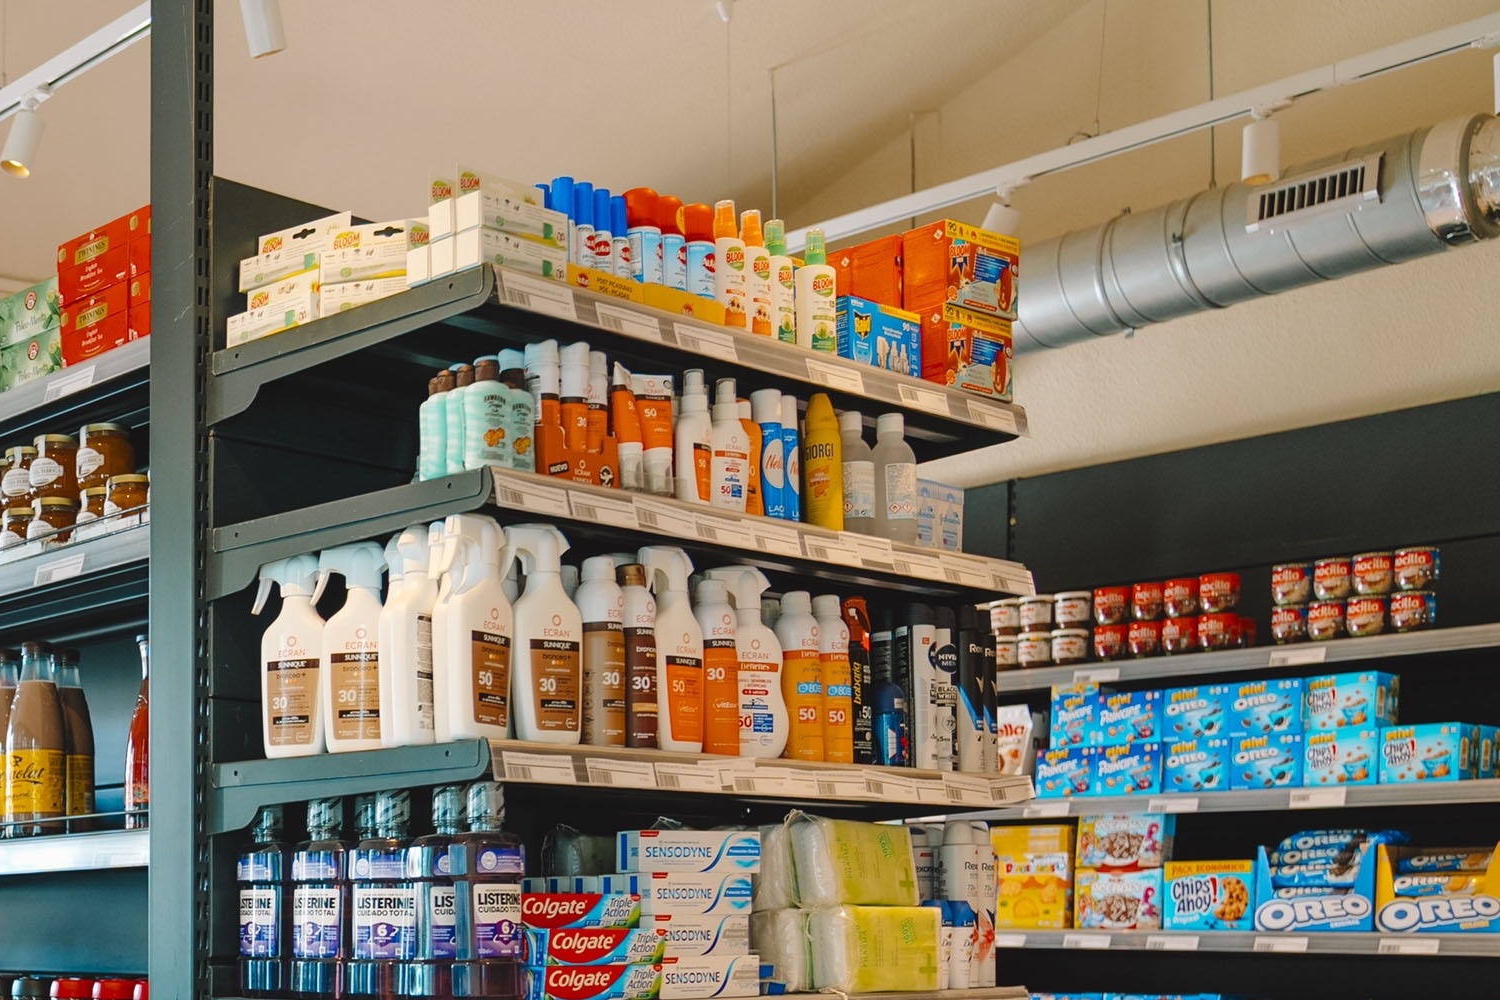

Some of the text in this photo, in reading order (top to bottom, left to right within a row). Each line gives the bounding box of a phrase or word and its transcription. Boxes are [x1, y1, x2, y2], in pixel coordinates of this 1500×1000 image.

[460, 177, 480, 189] BLOOM
[432, 185, 452, 198] BLOOM
[333, 232, 360, 250] BLOOM
[410, 231, 429, 244] BLOOM
[262, 238, 283, 254] BLOOM
[812, 279, 834, 291] BLOOM
[251, 293, 269, 309] BLOOM
[644, 408, 657, 418] 50
[550, 463, 568, 474] NUEVO
[720, 485, 731, 495] 50
[1355, 558, 1390, 572] nocilla
[483, 621, 506, 632] ECRAN
[543, 628, 570, 637] ECRAN
[345, 641, 377, 650] ECRAN
[278, 650, 305, 658] ECRAN
[742, 651, 769, 660] ECRAN
[478, 672, 493, 686] 50
[602, 672, 620, 685] 30
[706, 668, 725, 680] 30
[540, 678, 557, 692] 30
[632, 676, 650, 690] 30
[672, 680, 685, 692] 50
[338, 690, 356, 702] 30
[1233, 693, 1277, 711] OREO
[1307, 689, 1332, 704] Chips
[272, 697, 287, 709] 30
[1166, 700, 1208, 715] OREO
[799, 708, 816, 720] 50
[829, 711, 845, 723] 50
[1307, 745, 1331, 760] Chips
[1384, 741, 1409, 755] Chips
[1166, 752, 1207, 767] OREO
[1234, 748, 1278, 763] OREO
[1296, 835, 1350, 850] OREO
[645, 846, 712, 858] SENSODYNE
[1283, 849, 1338, 864] OREO
[657, 888, 712, 899] SENSODYNE
[1173, 880, 1211, 900] Chips
[357, 896, 414, 909] LISTERINE
[523, 897, 587, 917] Colgate
[610, 898, 633, 910] Triple
[357, 909, 414, 917] CUIDADO TOTAL
[478, 905, 508, 914] CUIDADO
[603, 907, 630, 919] Action
[1258, 894, 1370, 931] OREO
[1378, 894, 1500, 932] OREO
[377, 924, 387, 938] 6
[501, 921, 510, 934] 6
[637, 933, 659, 946] Triple
[664, 930, 711, 941] ENSODYNE
[552, 932, 614, 953] Colgate
[630, 942, 656, 954] Action
[549, 969, 611, 990] Colgate
[633, 970, 656, 982] Triple
[666, 972, 720, 984] SENSODYNE
[627, 979, 653, 990] Action
